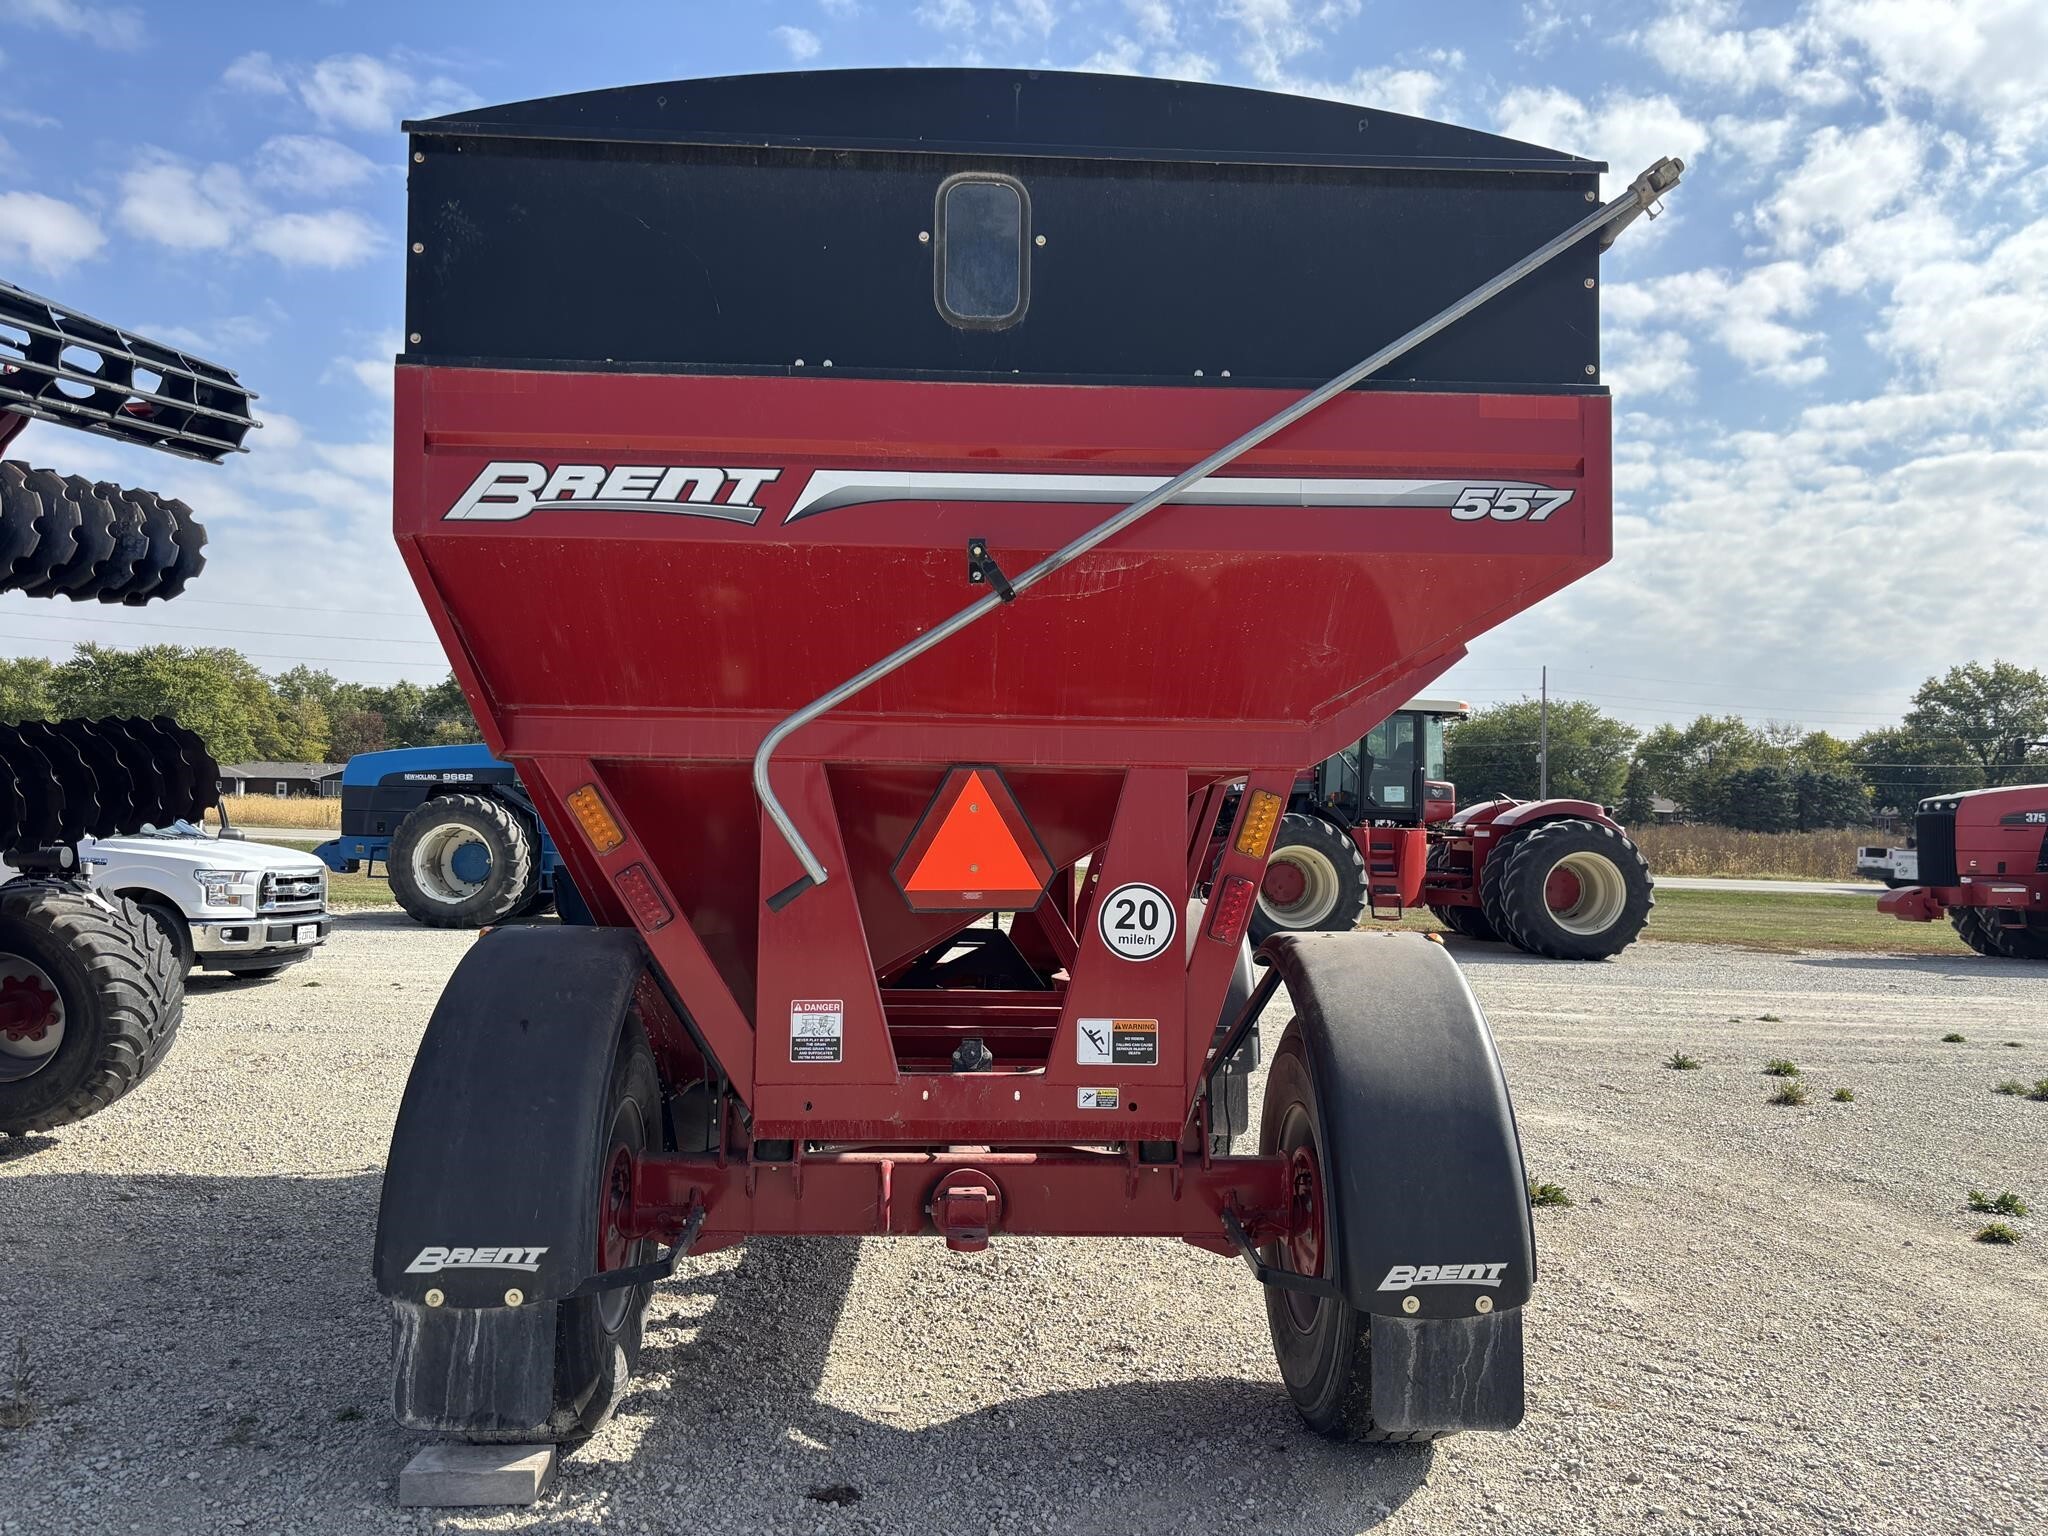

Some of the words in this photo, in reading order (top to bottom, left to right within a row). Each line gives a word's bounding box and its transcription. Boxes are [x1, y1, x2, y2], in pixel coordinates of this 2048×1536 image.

[1450, 488, 1576, 522] 557
[443, 773, 473, 781] 9682
[2026, 812, 2046, 823] 375
[1115, 899, 1158, 930] 20
[1118, 934, 1155, 945] mile/h
[404, 1247, 549, 1273] BRENT
[1377, 1262, 1510, 1291] BRENT
